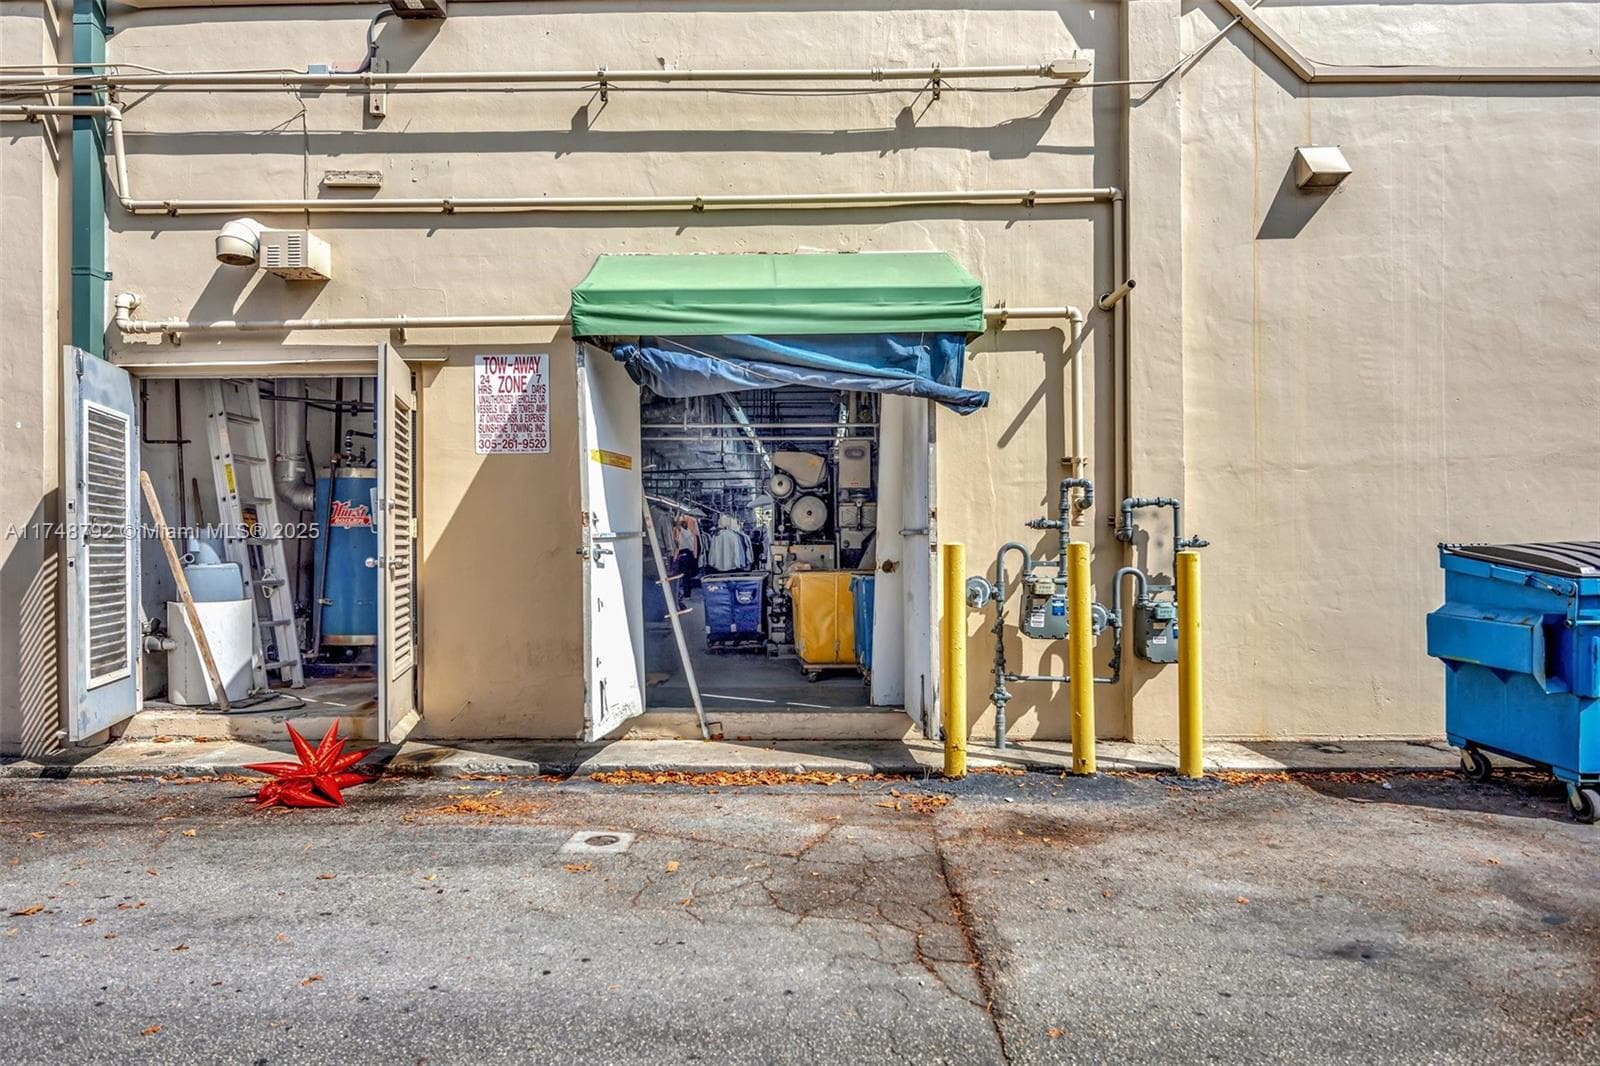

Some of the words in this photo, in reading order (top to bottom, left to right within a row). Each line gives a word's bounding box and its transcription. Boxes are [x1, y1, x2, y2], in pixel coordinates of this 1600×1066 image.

[482, 356, 541, 374] TOW-AWAY
[480, 374, 491, 385] 24
[498, 375, 528, 393] ZONE
[535, 374, 542, 384] 7
[477, 384, 493, 395] HRS
[531, 384, 547, 394] DAYS
[478, 423, 508, 433] SUNSHINE
[510, 423, 534, 433] TOWING
[478, 439, 547, 449] 305-261-9520
